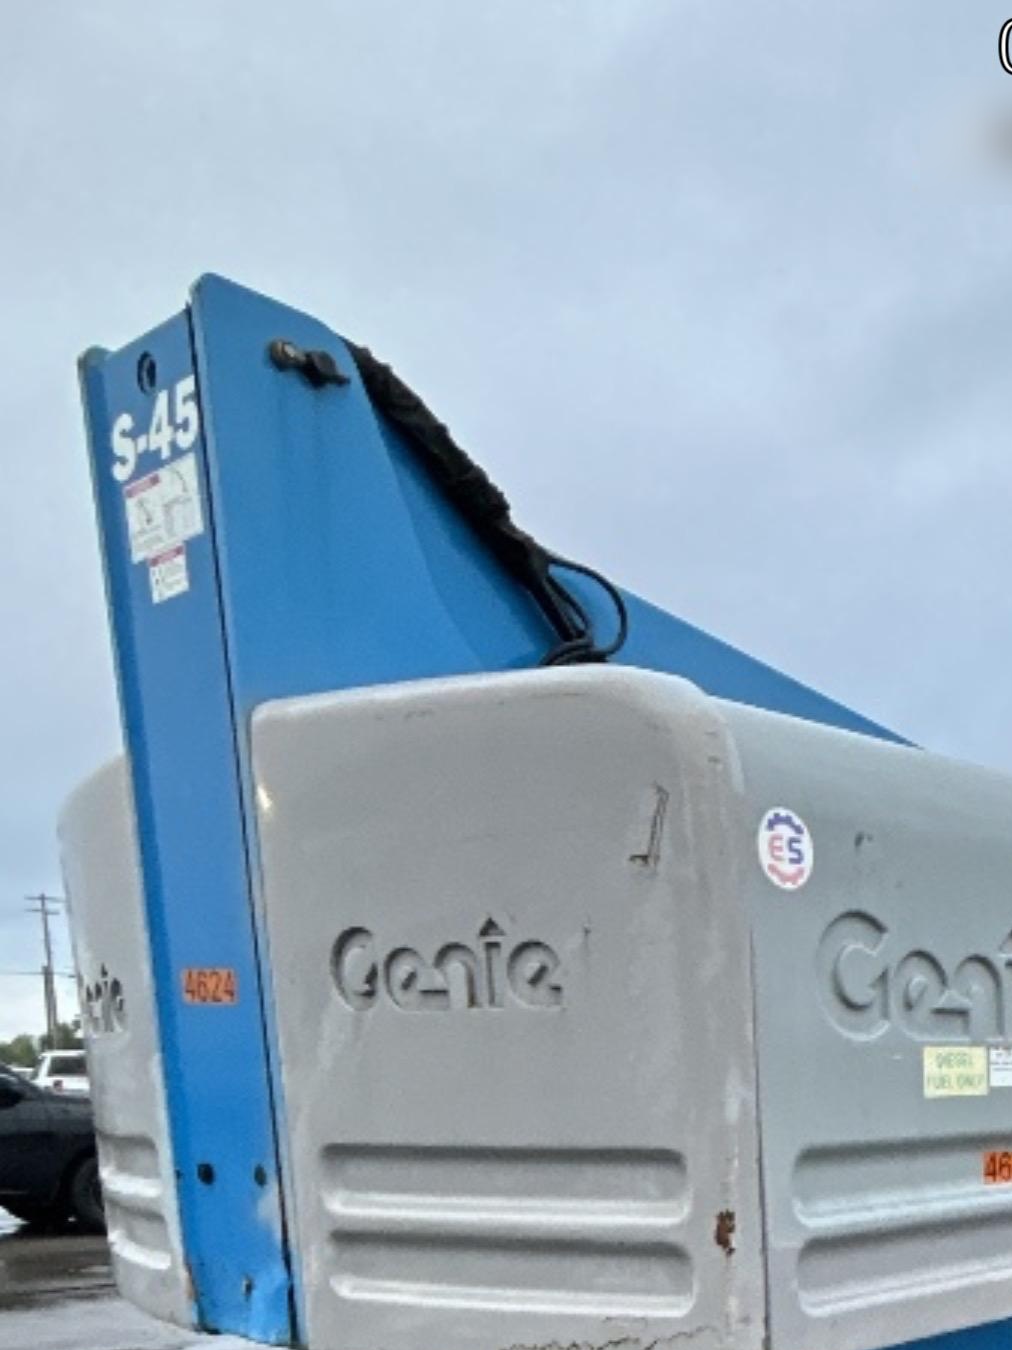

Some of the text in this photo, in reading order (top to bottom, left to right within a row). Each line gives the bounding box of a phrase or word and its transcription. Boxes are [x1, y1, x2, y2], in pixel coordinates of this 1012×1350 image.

[112, 374, 198, 482] S-45
[768, 833, 804, 864] ES
[183, 968, 237, 1003] 4624
[330, 914, 563, 1013] Genie
